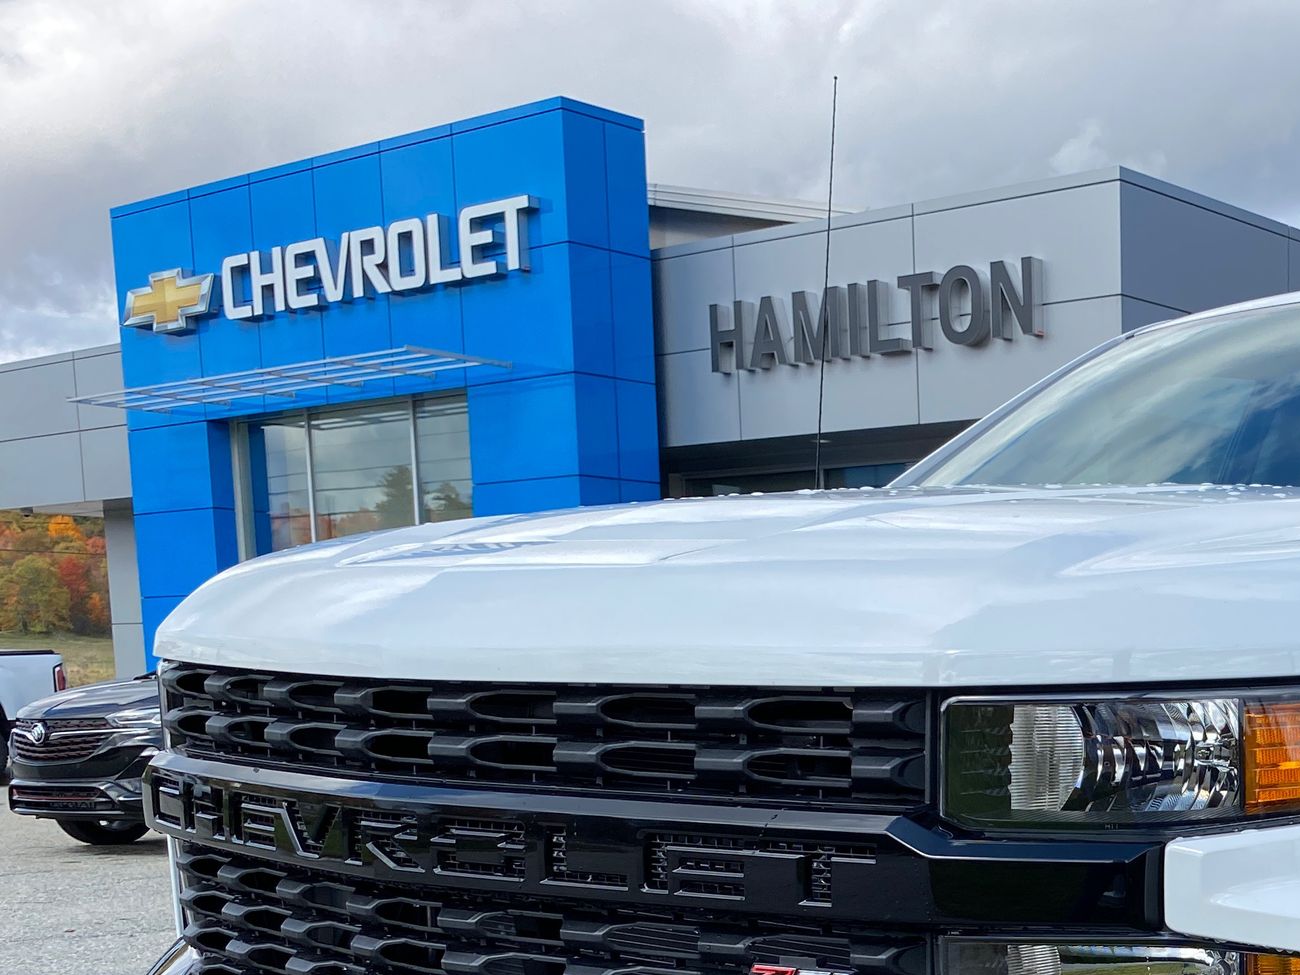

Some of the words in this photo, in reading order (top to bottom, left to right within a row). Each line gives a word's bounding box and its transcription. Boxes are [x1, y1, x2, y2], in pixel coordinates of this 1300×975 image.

[222, 195, 538, 320] CHEVROLET
[709, 256, 1044, 374] HAMILTON
[152, 772, 877, 908] CHEVROLET
